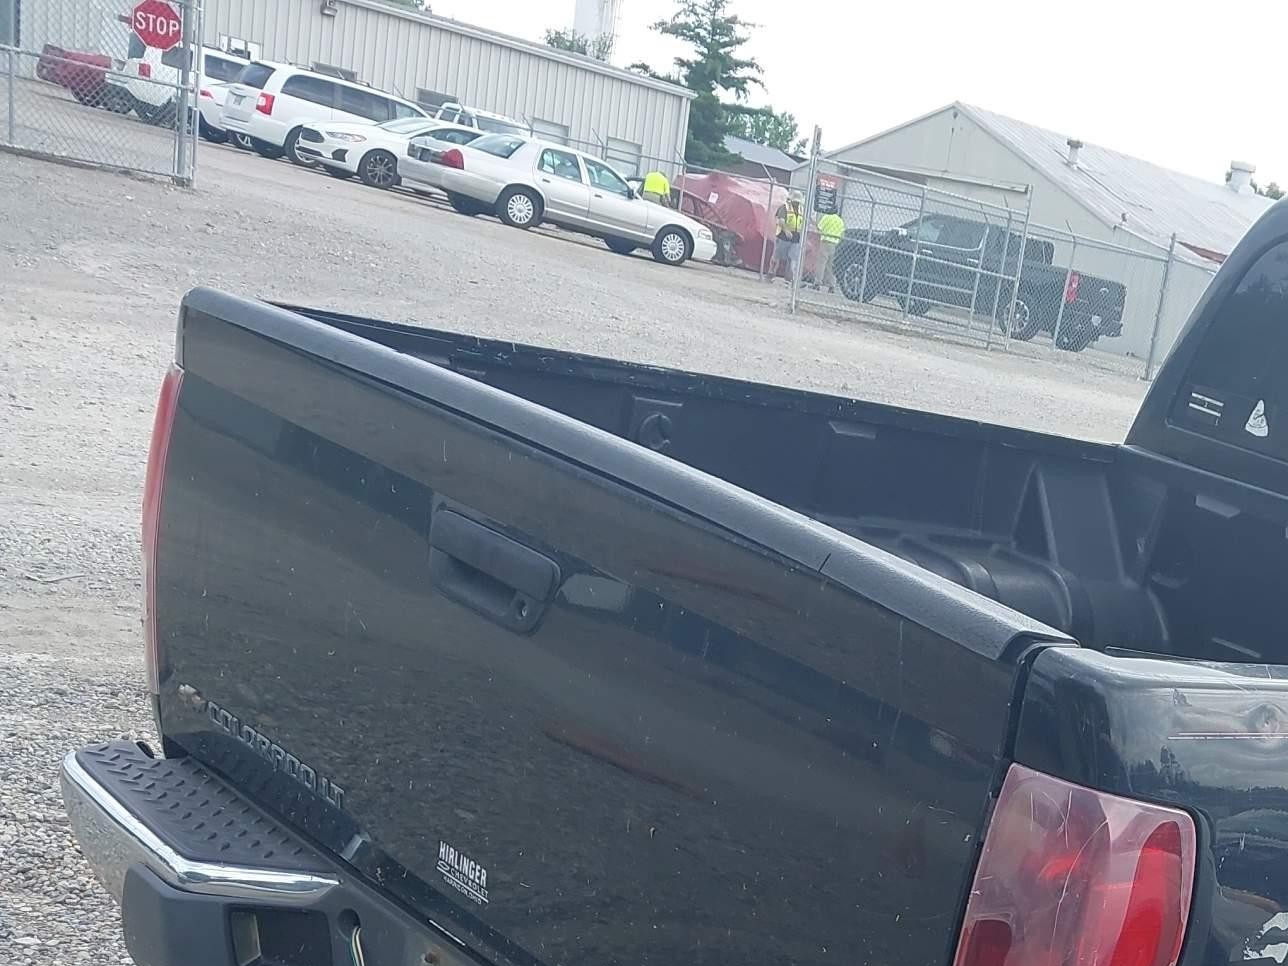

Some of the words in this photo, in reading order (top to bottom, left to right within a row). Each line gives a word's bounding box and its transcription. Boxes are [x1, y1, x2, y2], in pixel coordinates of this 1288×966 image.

[135, 11, 179, 37] STOP
[207, 701, 318, 793] COLORADO
[439, 840, 487, 888] HIRLINGER
[450, 867, 489, 899] CHEVROLET
